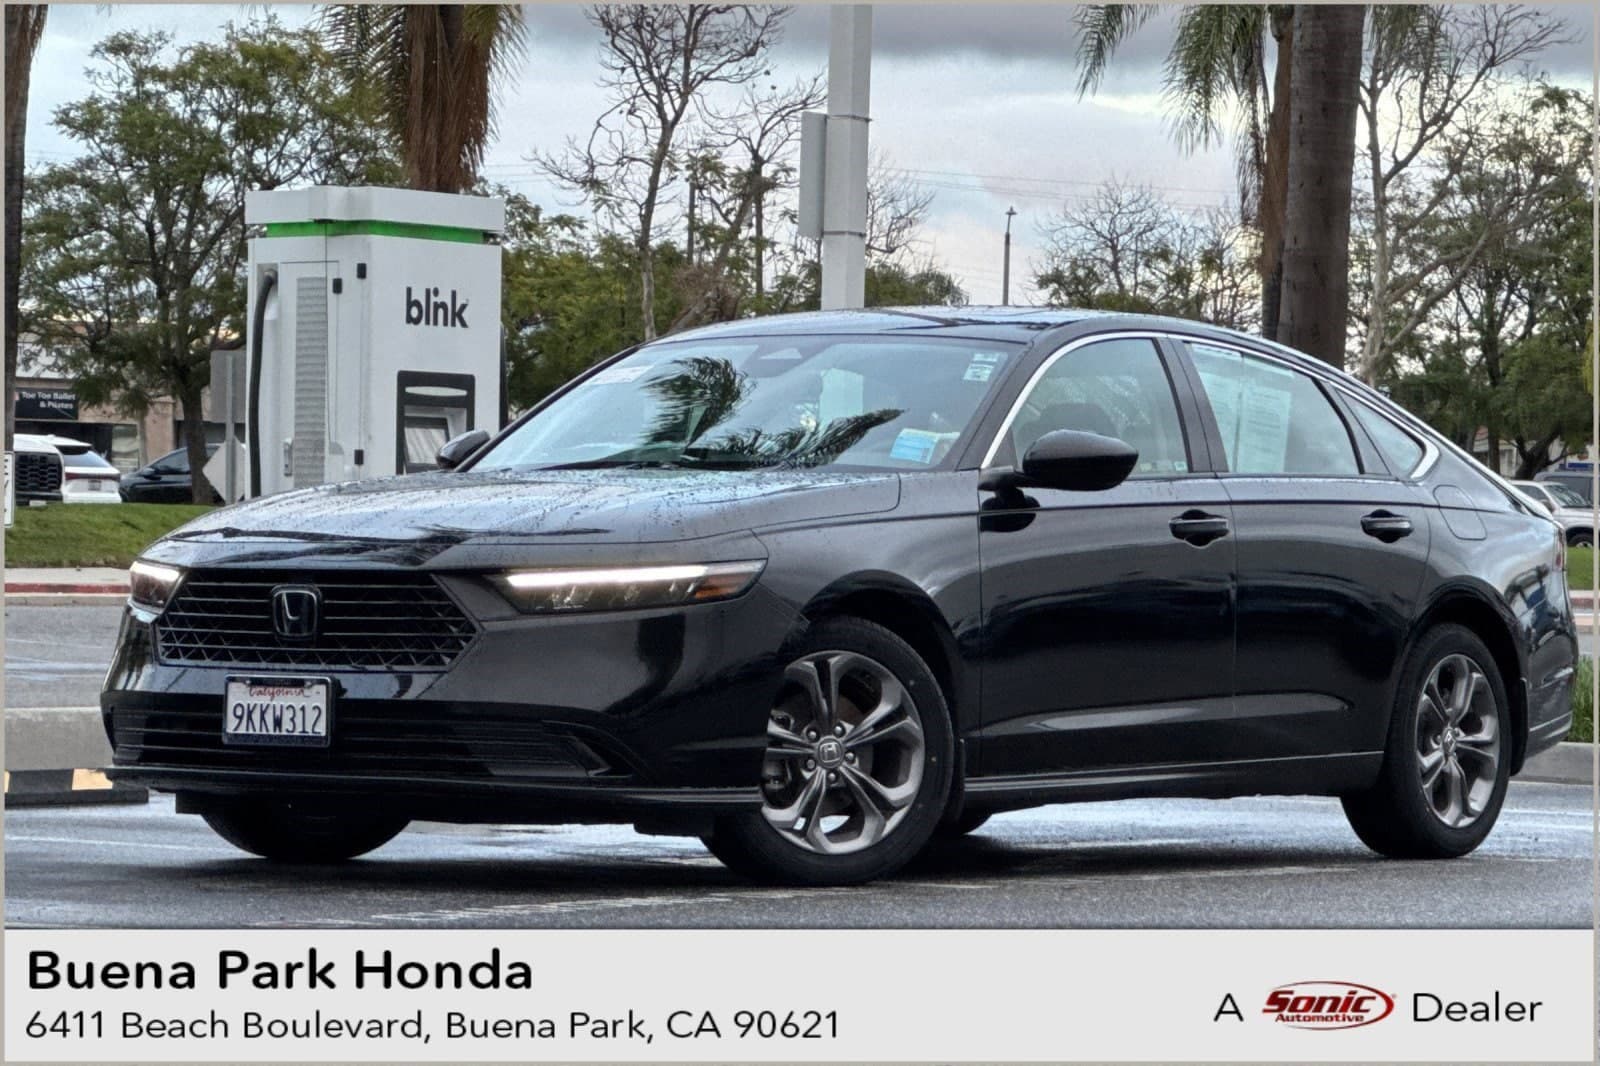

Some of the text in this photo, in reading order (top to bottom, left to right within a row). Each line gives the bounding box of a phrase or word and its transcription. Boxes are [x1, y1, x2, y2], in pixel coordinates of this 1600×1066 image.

[405, 286, 469, 329] blink
[249, 685, 305, 701] California
[232, 702, 323, 734] 9KKW312
